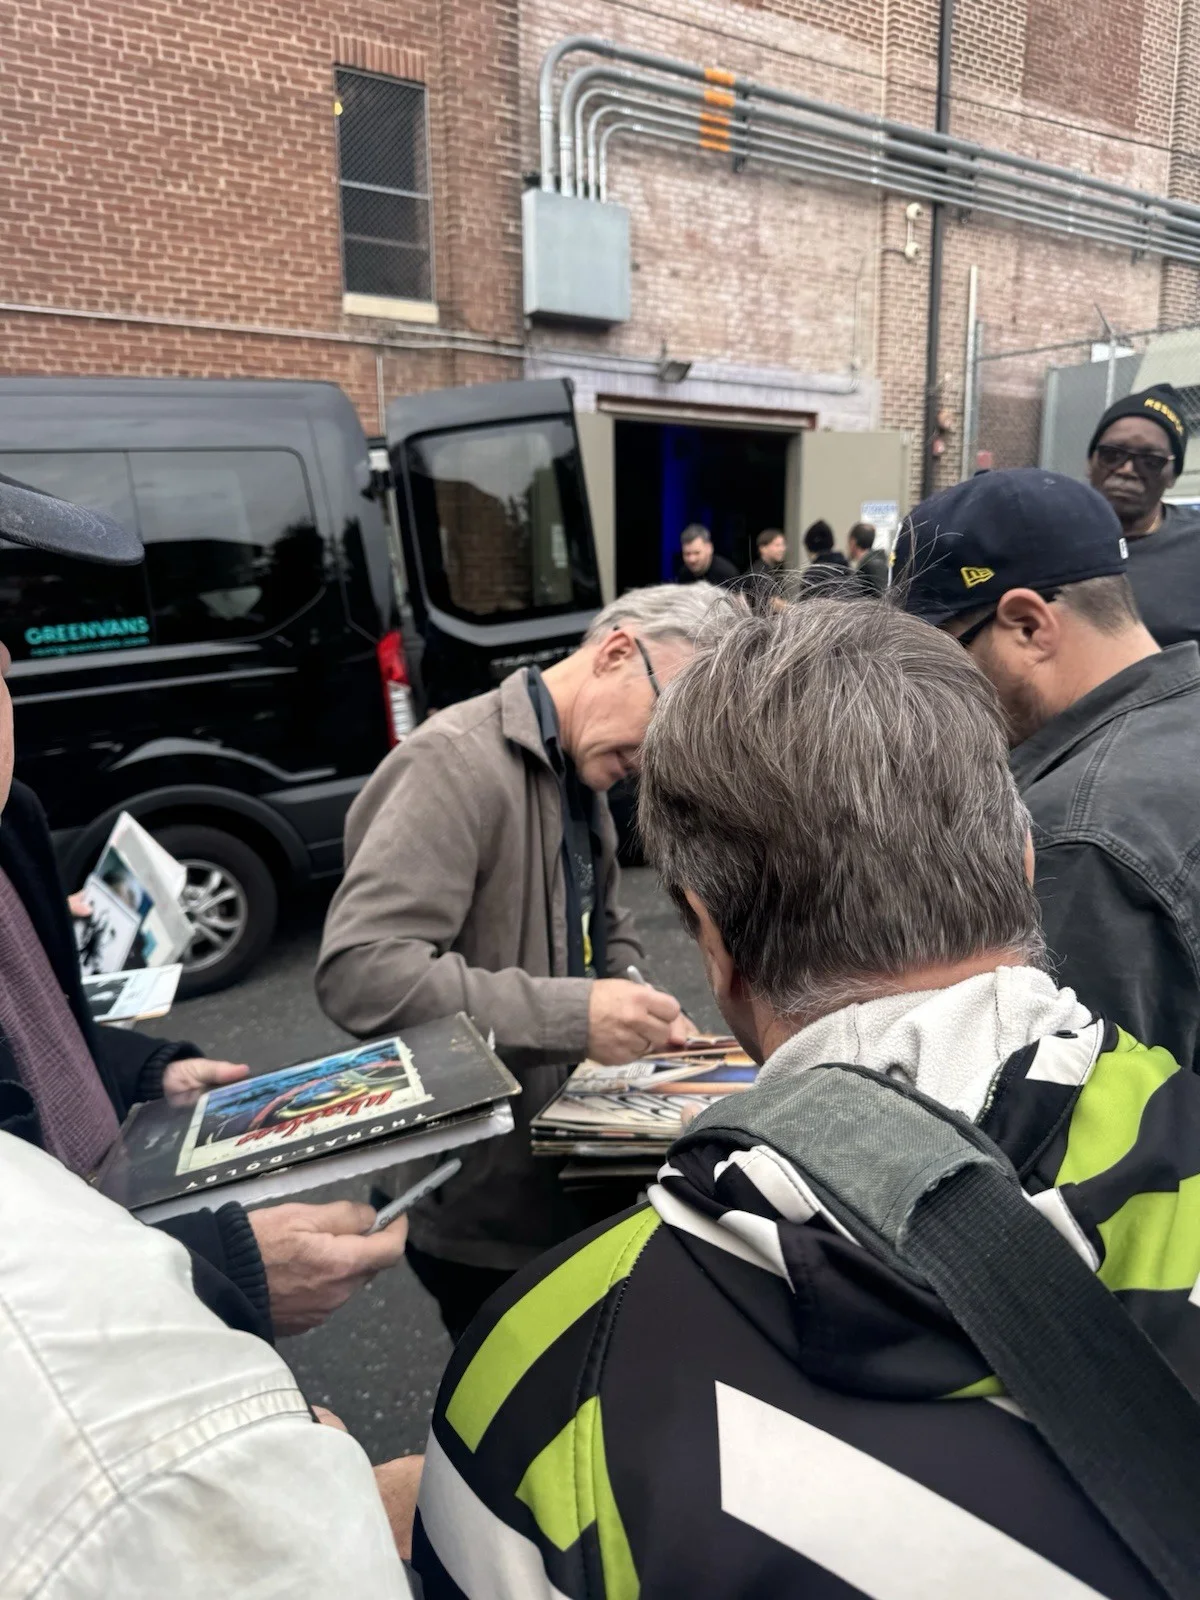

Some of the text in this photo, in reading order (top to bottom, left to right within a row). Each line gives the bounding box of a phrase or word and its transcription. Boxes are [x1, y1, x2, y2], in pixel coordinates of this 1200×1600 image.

[24, 616, 149, 645] GREENVANS
[306, 1113, 427, 1153] THOMAS
[185, 1154, 283, 1190] DOLBY
